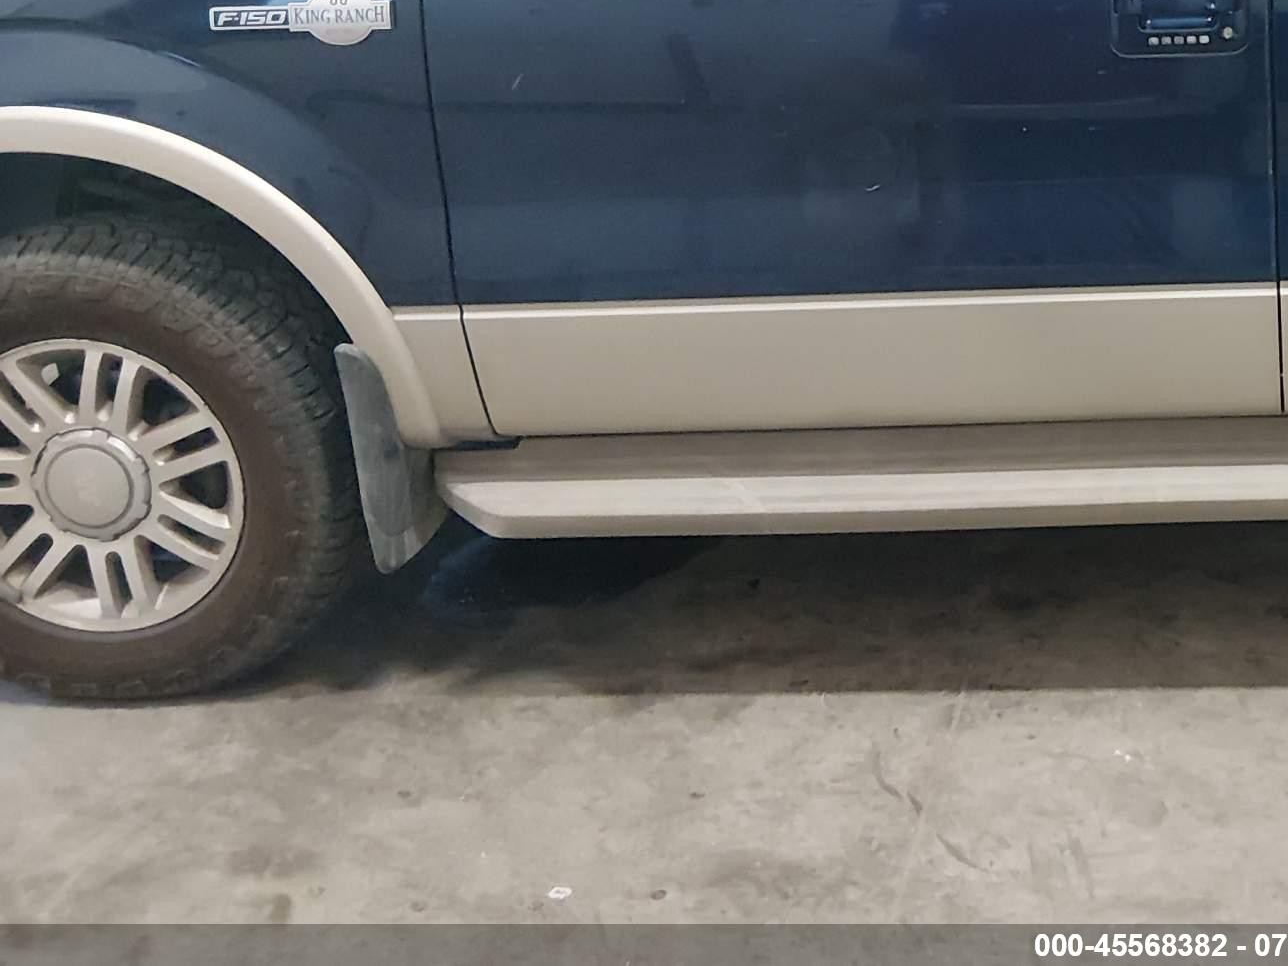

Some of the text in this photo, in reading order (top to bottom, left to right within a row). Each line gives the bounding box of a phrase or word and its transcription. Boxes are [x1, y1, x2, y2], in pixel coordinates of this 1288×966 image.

[217, 10, 287, 26] F-150
[294, 5, 385, 25] KING RANCH
